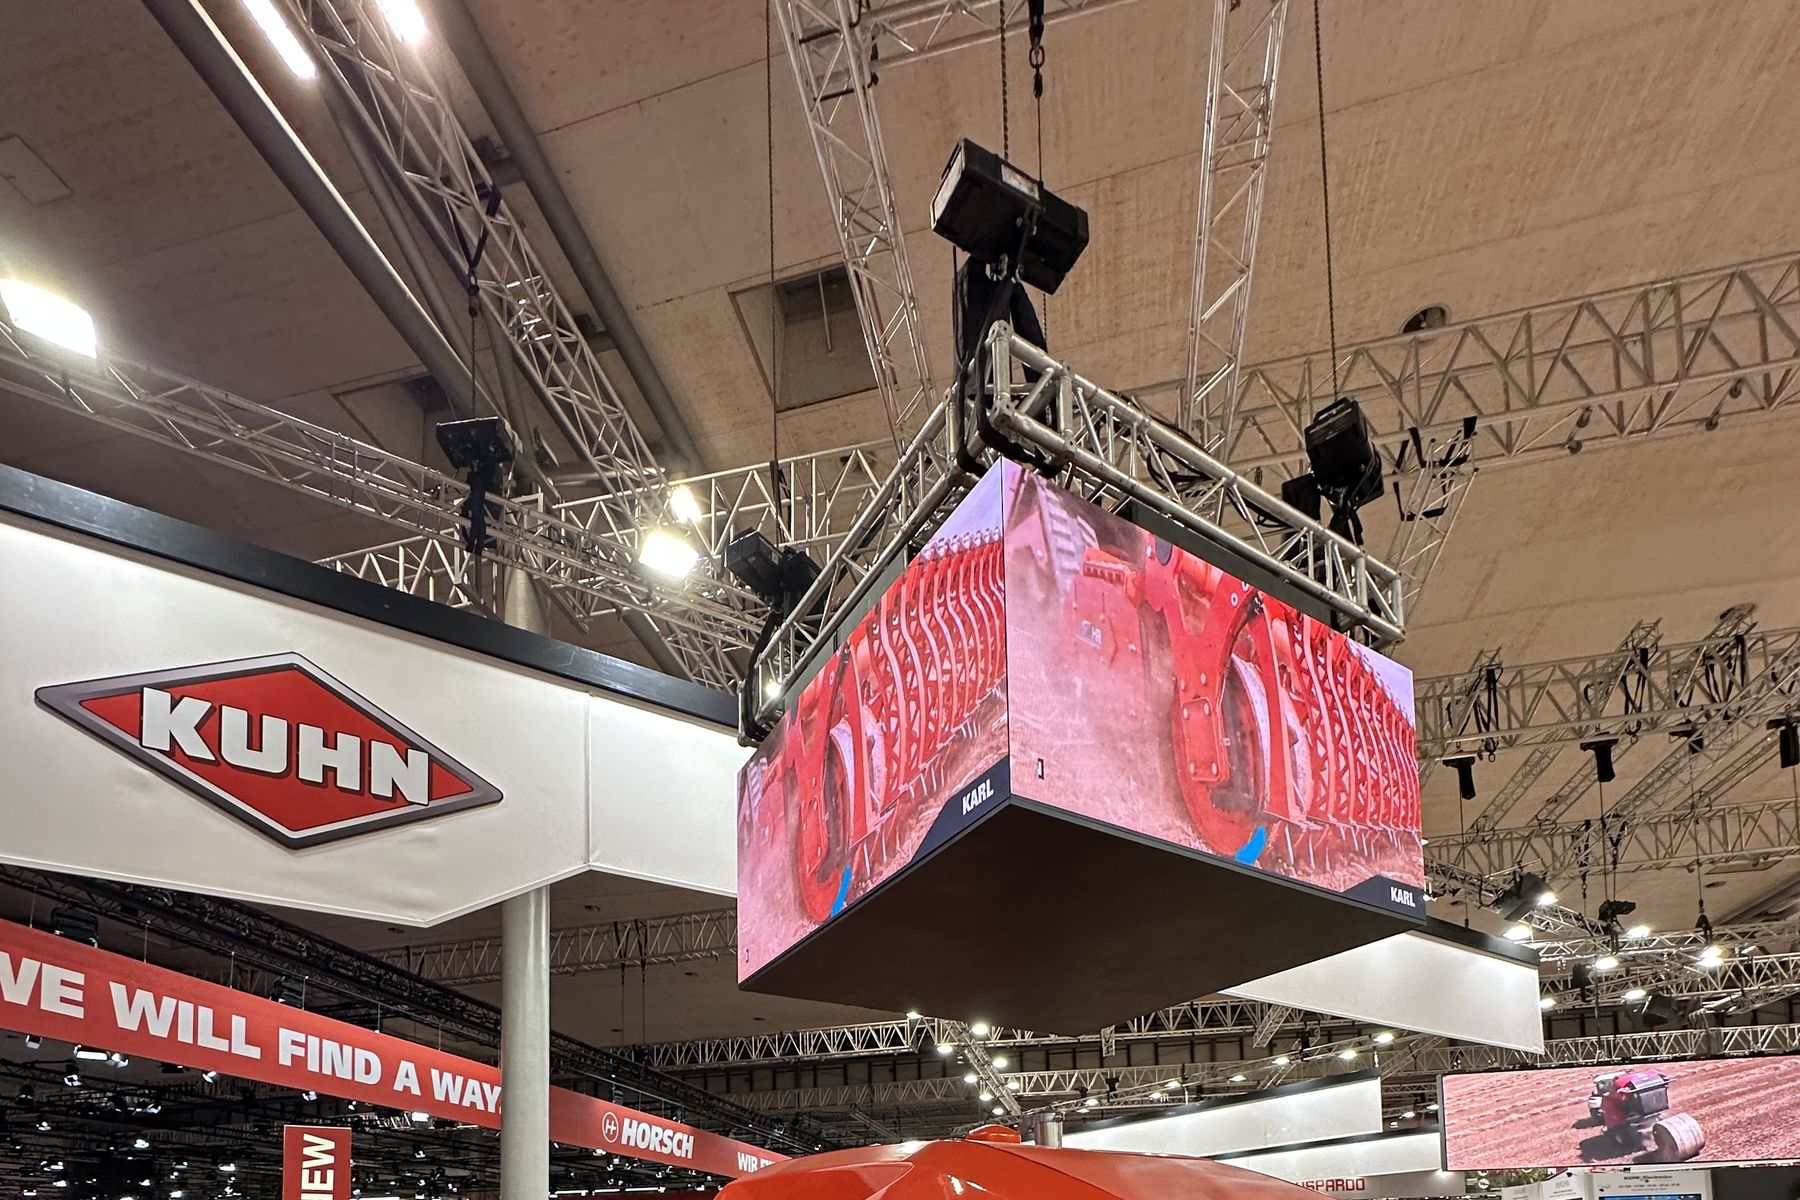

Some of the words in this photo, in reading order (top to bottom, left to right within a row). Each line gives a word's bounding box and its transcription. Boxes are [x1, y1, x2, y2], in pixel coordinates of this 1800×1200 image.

[141, 686, 430, 806] KUHN
[962, 778, 994, 816] KARL
[1390, 886, 1416, 908] KARL
[109, 981, 261, 1060] WILL
[278, 1027, 382, 1086] FIND
[393, 1059, 422, 1096] A
[430, 1067, 502, 1114] WAY
[620, 1117, 695, 1160] HORSCH
[737, 1151, 759, 1174] WIR
[1300, 1178, 1365, 1192] SPARDO
